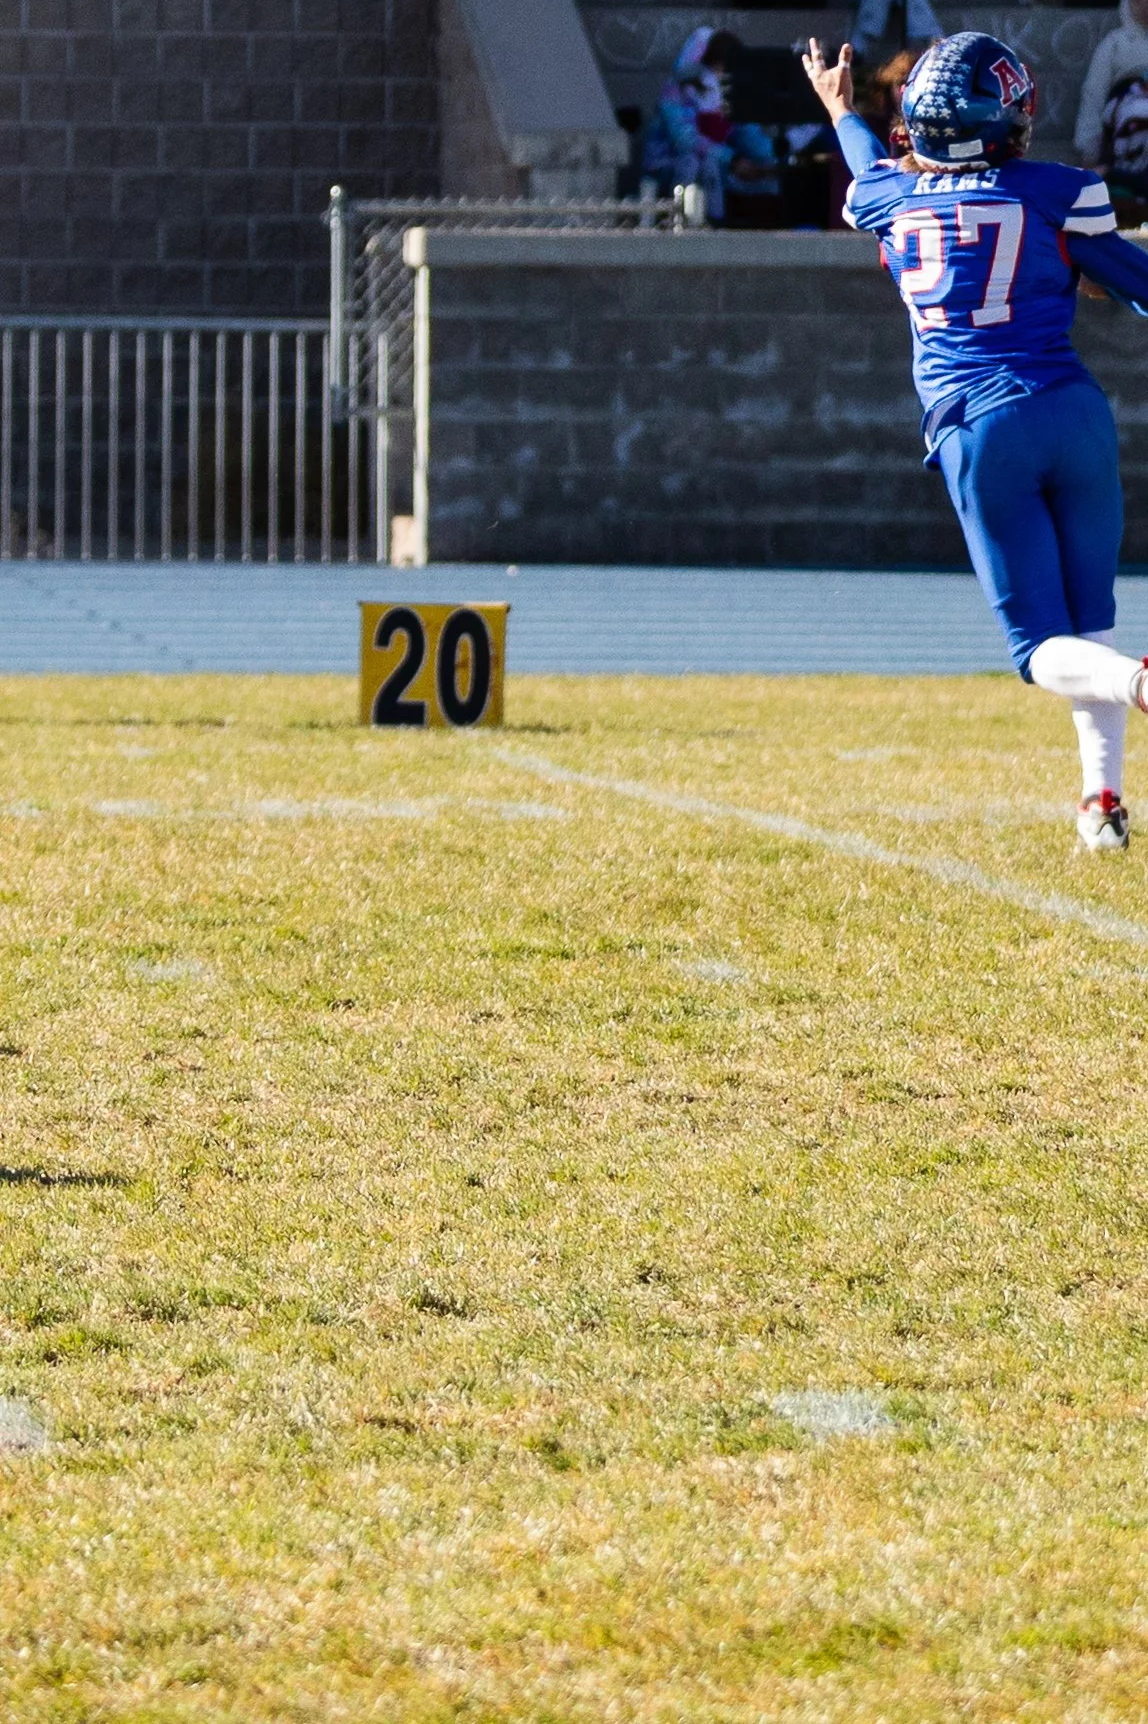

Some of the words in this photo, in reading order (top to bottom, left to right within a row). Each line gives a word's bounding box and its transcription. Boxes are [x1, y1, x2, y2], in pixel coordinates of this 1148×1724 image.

[988, 56, 1028, 109] A
[912, 167, 1001, 195] RAMS
[890, 202, 1026, 332] 27
[373, 606, 492, 727] 20
